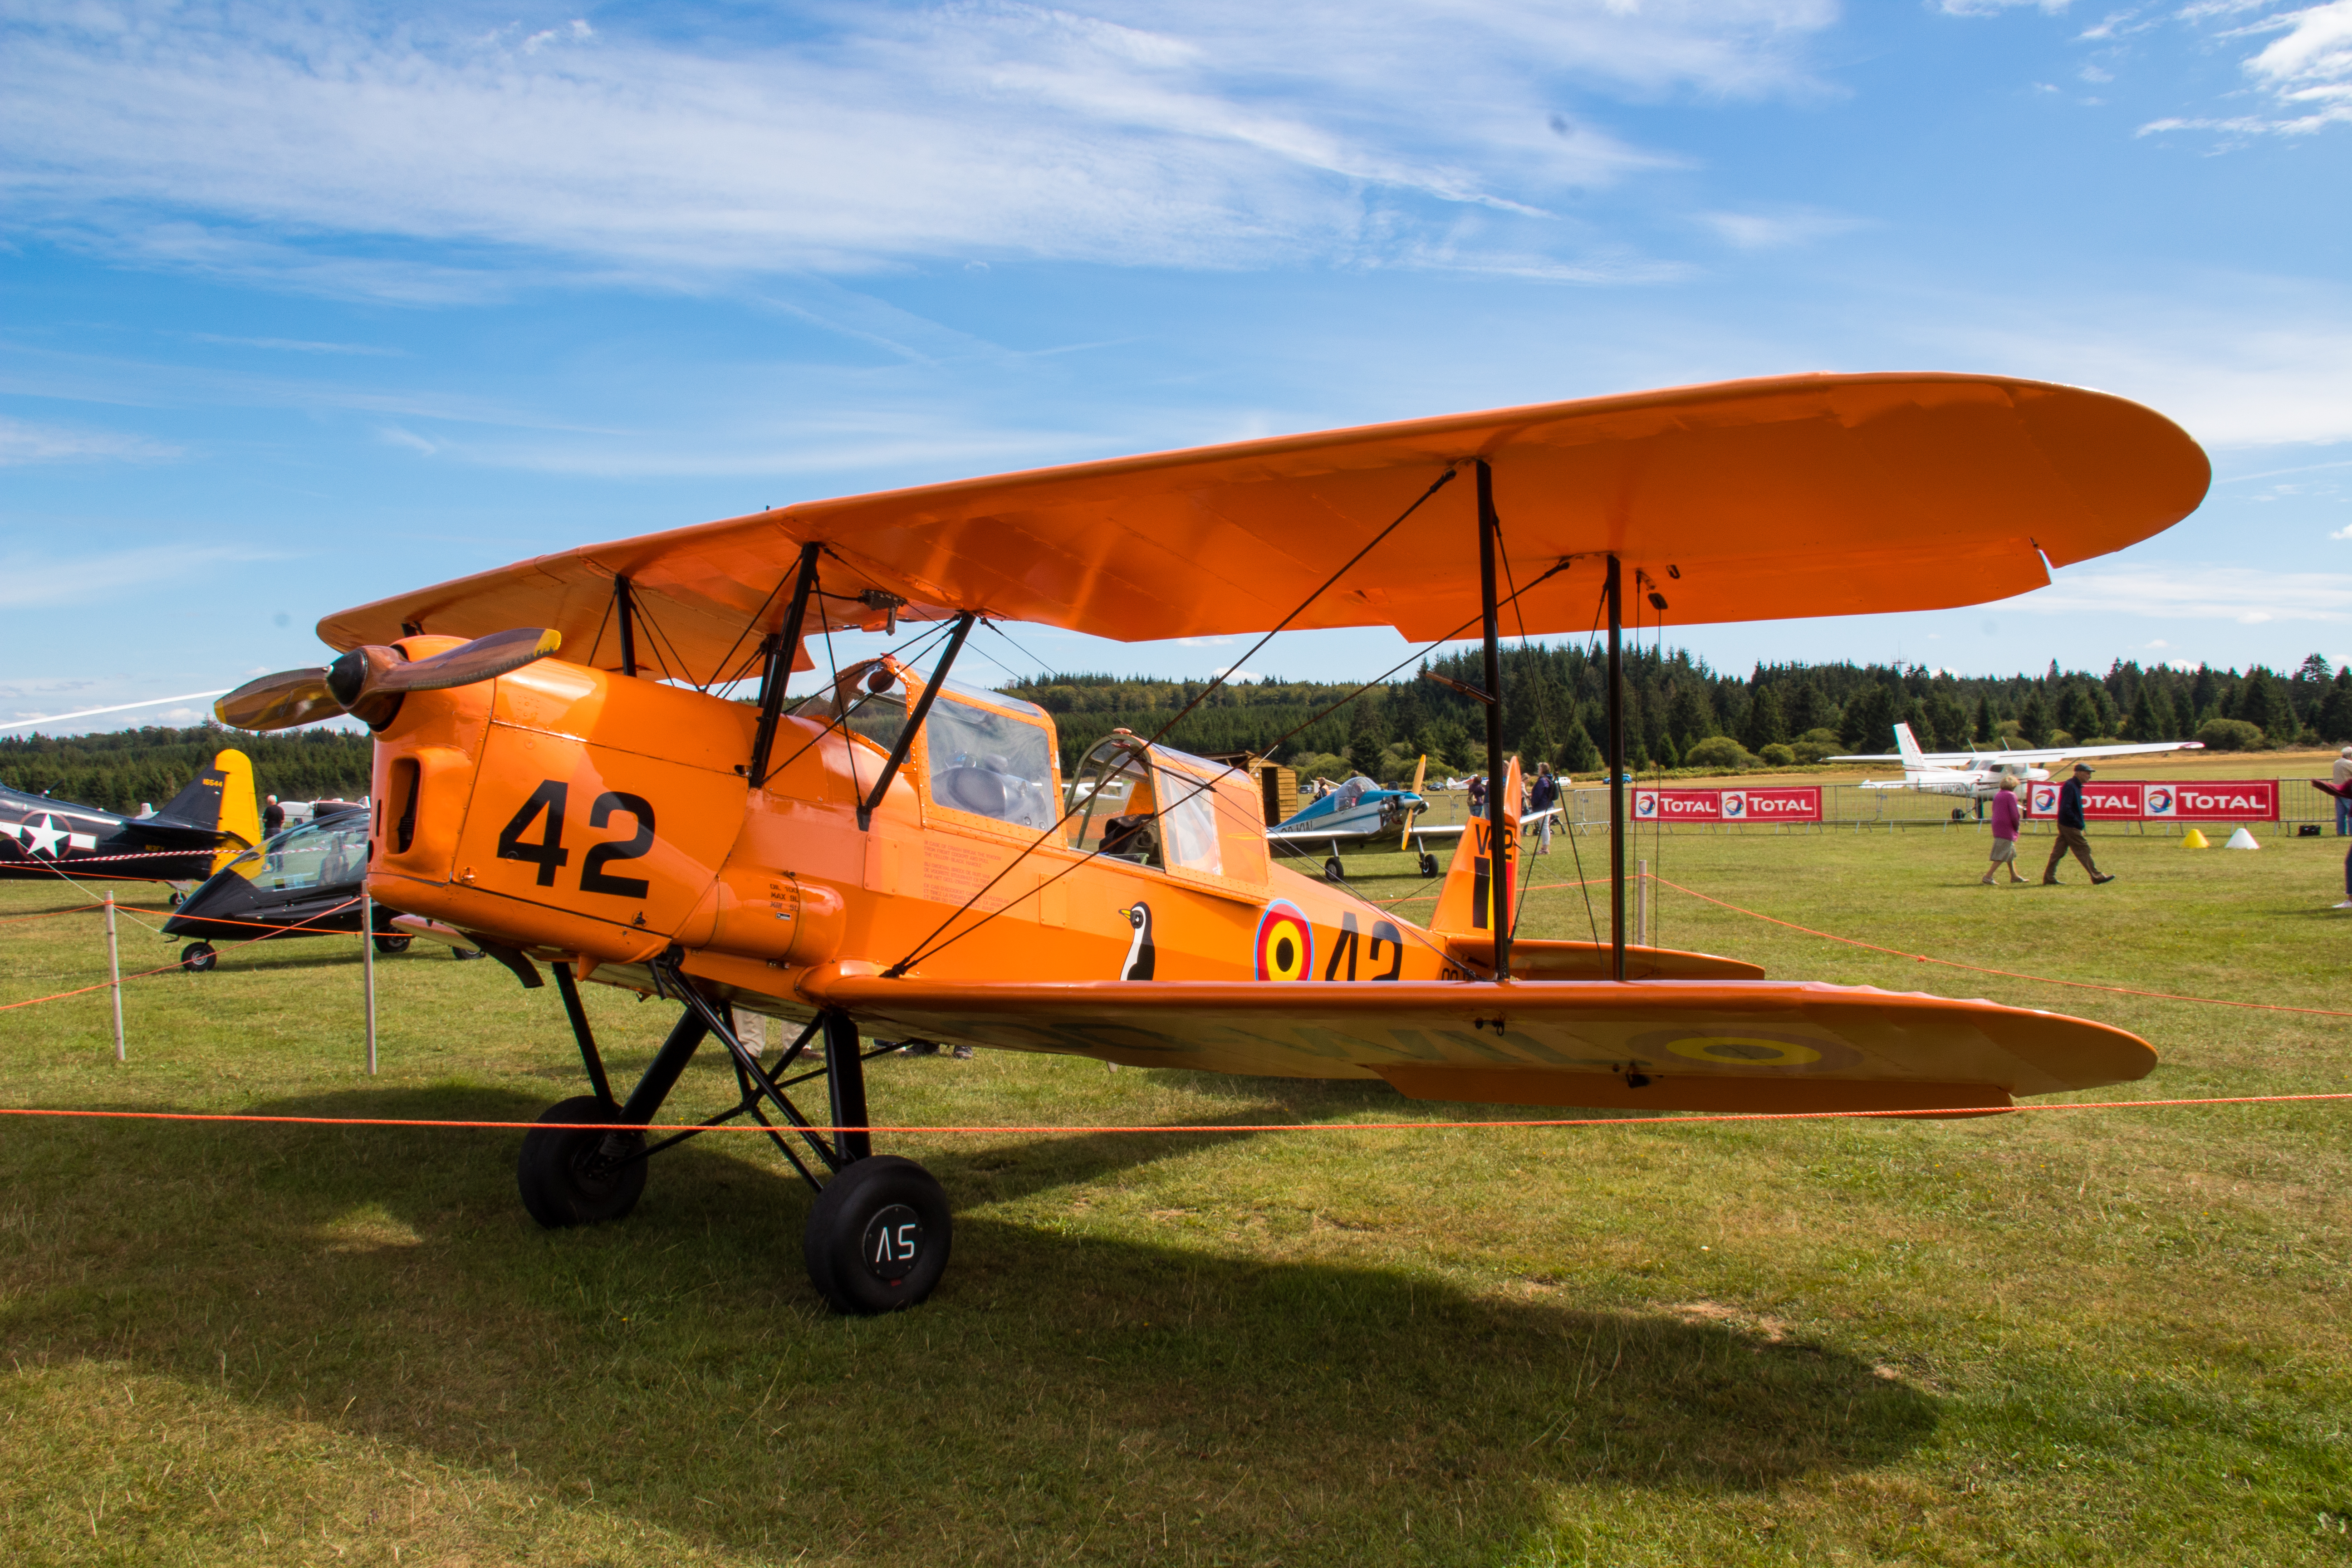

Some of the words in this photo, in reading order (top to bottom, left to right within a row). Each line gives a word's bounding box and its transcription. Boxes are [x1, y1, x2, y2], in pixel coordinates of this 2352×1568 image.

[1661, 798, 1716, 812] TOTAL
[1749, 797, 1813, 812] TOTAL
[2081, 795, 2136, 808] OTAL
[2180, 792, 2266, 809] TOTAL
[497, 779, 656, 899] 42
[1325, 911, 1403, 981] 42
